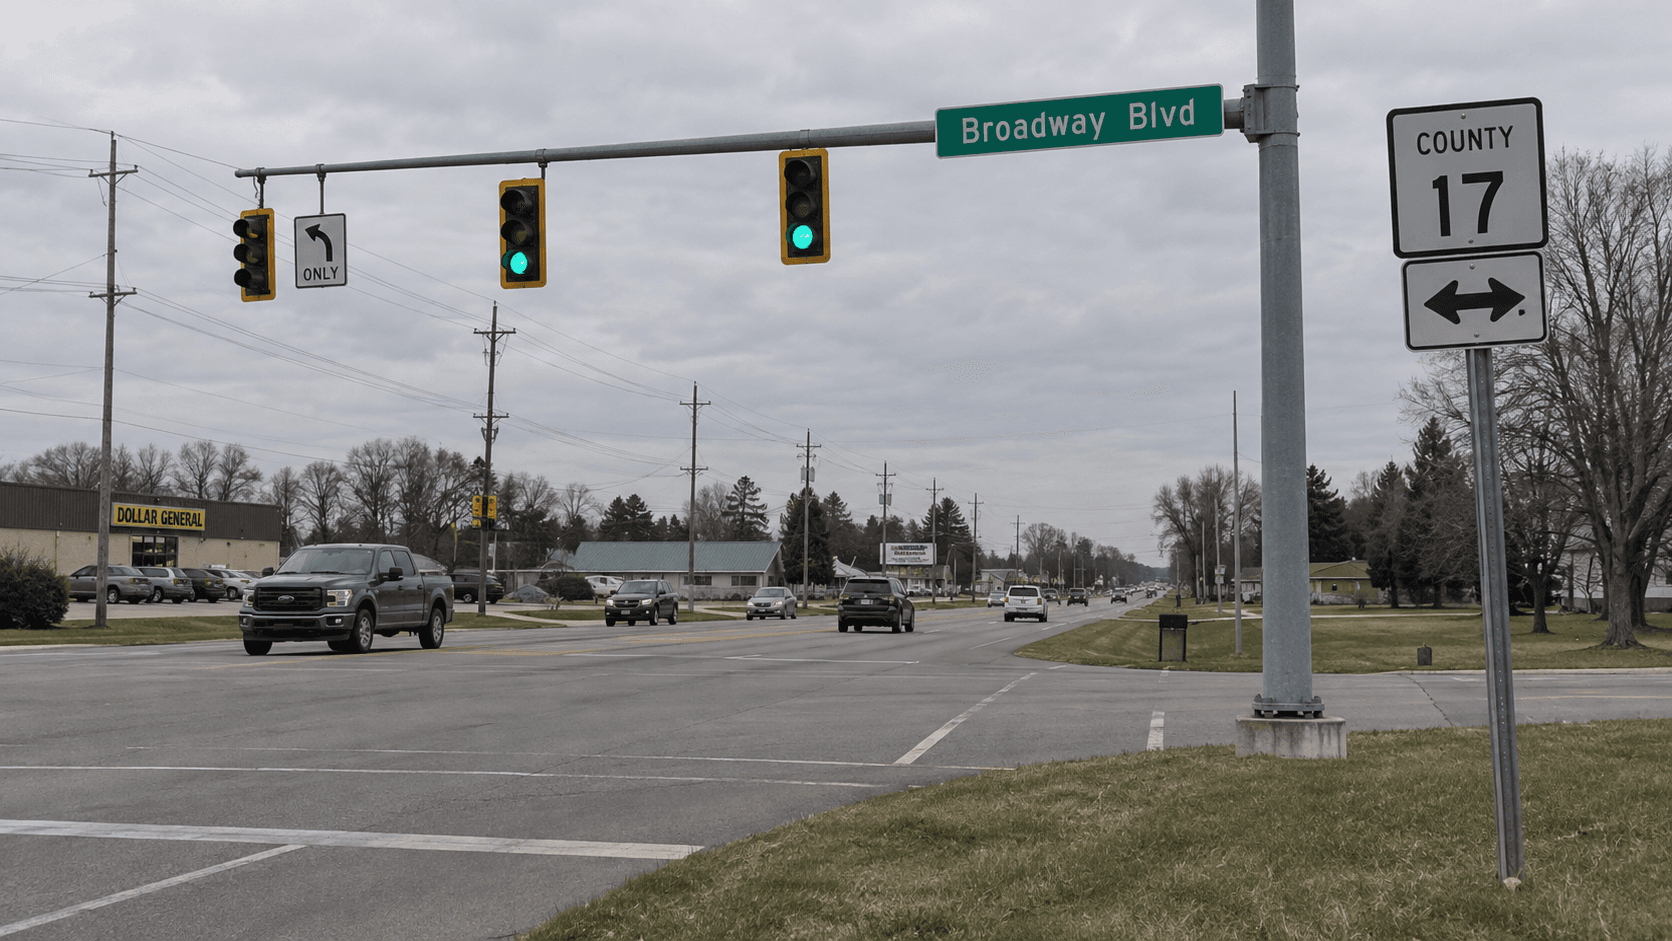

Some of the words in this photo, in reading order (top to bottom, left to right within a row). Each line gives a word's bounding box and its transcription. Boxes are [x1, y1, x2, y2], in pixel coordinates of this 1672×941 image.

[962, 110, 1106, 144] Broadway
[1129, 97, 1195, 130] Blvd
[1416, 125, 1514, 155] COUNTY
[1432, 170, 1504, 237] 17
[303, 265, 339, 281] ONLY
[117, 506, 158, 525] DOLLAR
[160, 510, 203, 527] GENERAL
